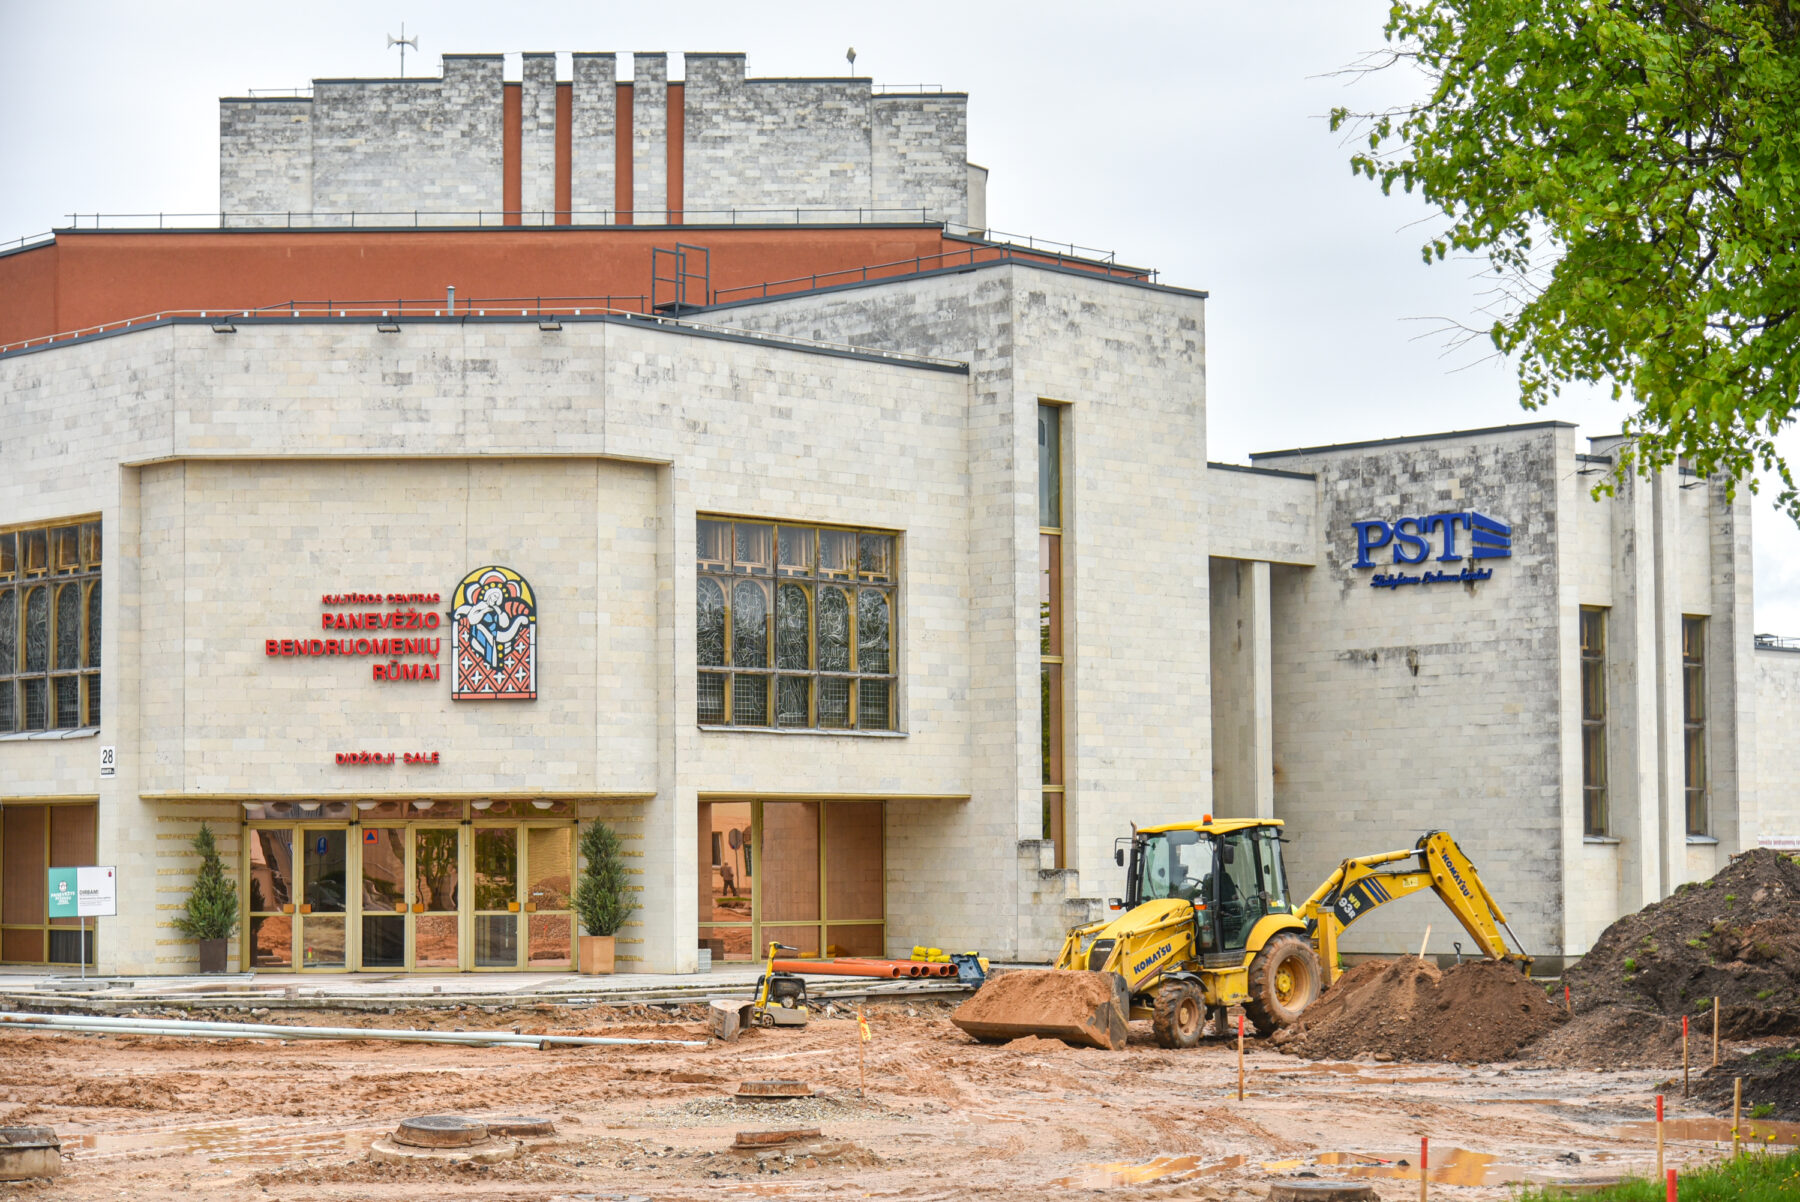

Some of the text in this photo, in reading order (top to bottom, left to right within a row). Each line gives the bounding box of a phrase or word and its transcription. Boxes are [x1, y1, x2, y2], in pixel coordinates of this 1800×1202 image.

[1351, 512, 1471, 568] PST
[322, 592, 440, 604] KULTŪROS CENTRAS
[322, 608, 440, 629] PANEVĖŽIO
[265, 637, 440, 658] BENDRUOMENIŲ
[373, 660, 440, 681] RŪMAI
[102, 749, 114, 764] 28
[335, 750, 395, 765] DIDŽIOJI
[1442, 854, 1470, 896] KOMATSU
[1338, 897, 1356, 919] 93R
[1133, 943, 1172, 975] KOMATSU
